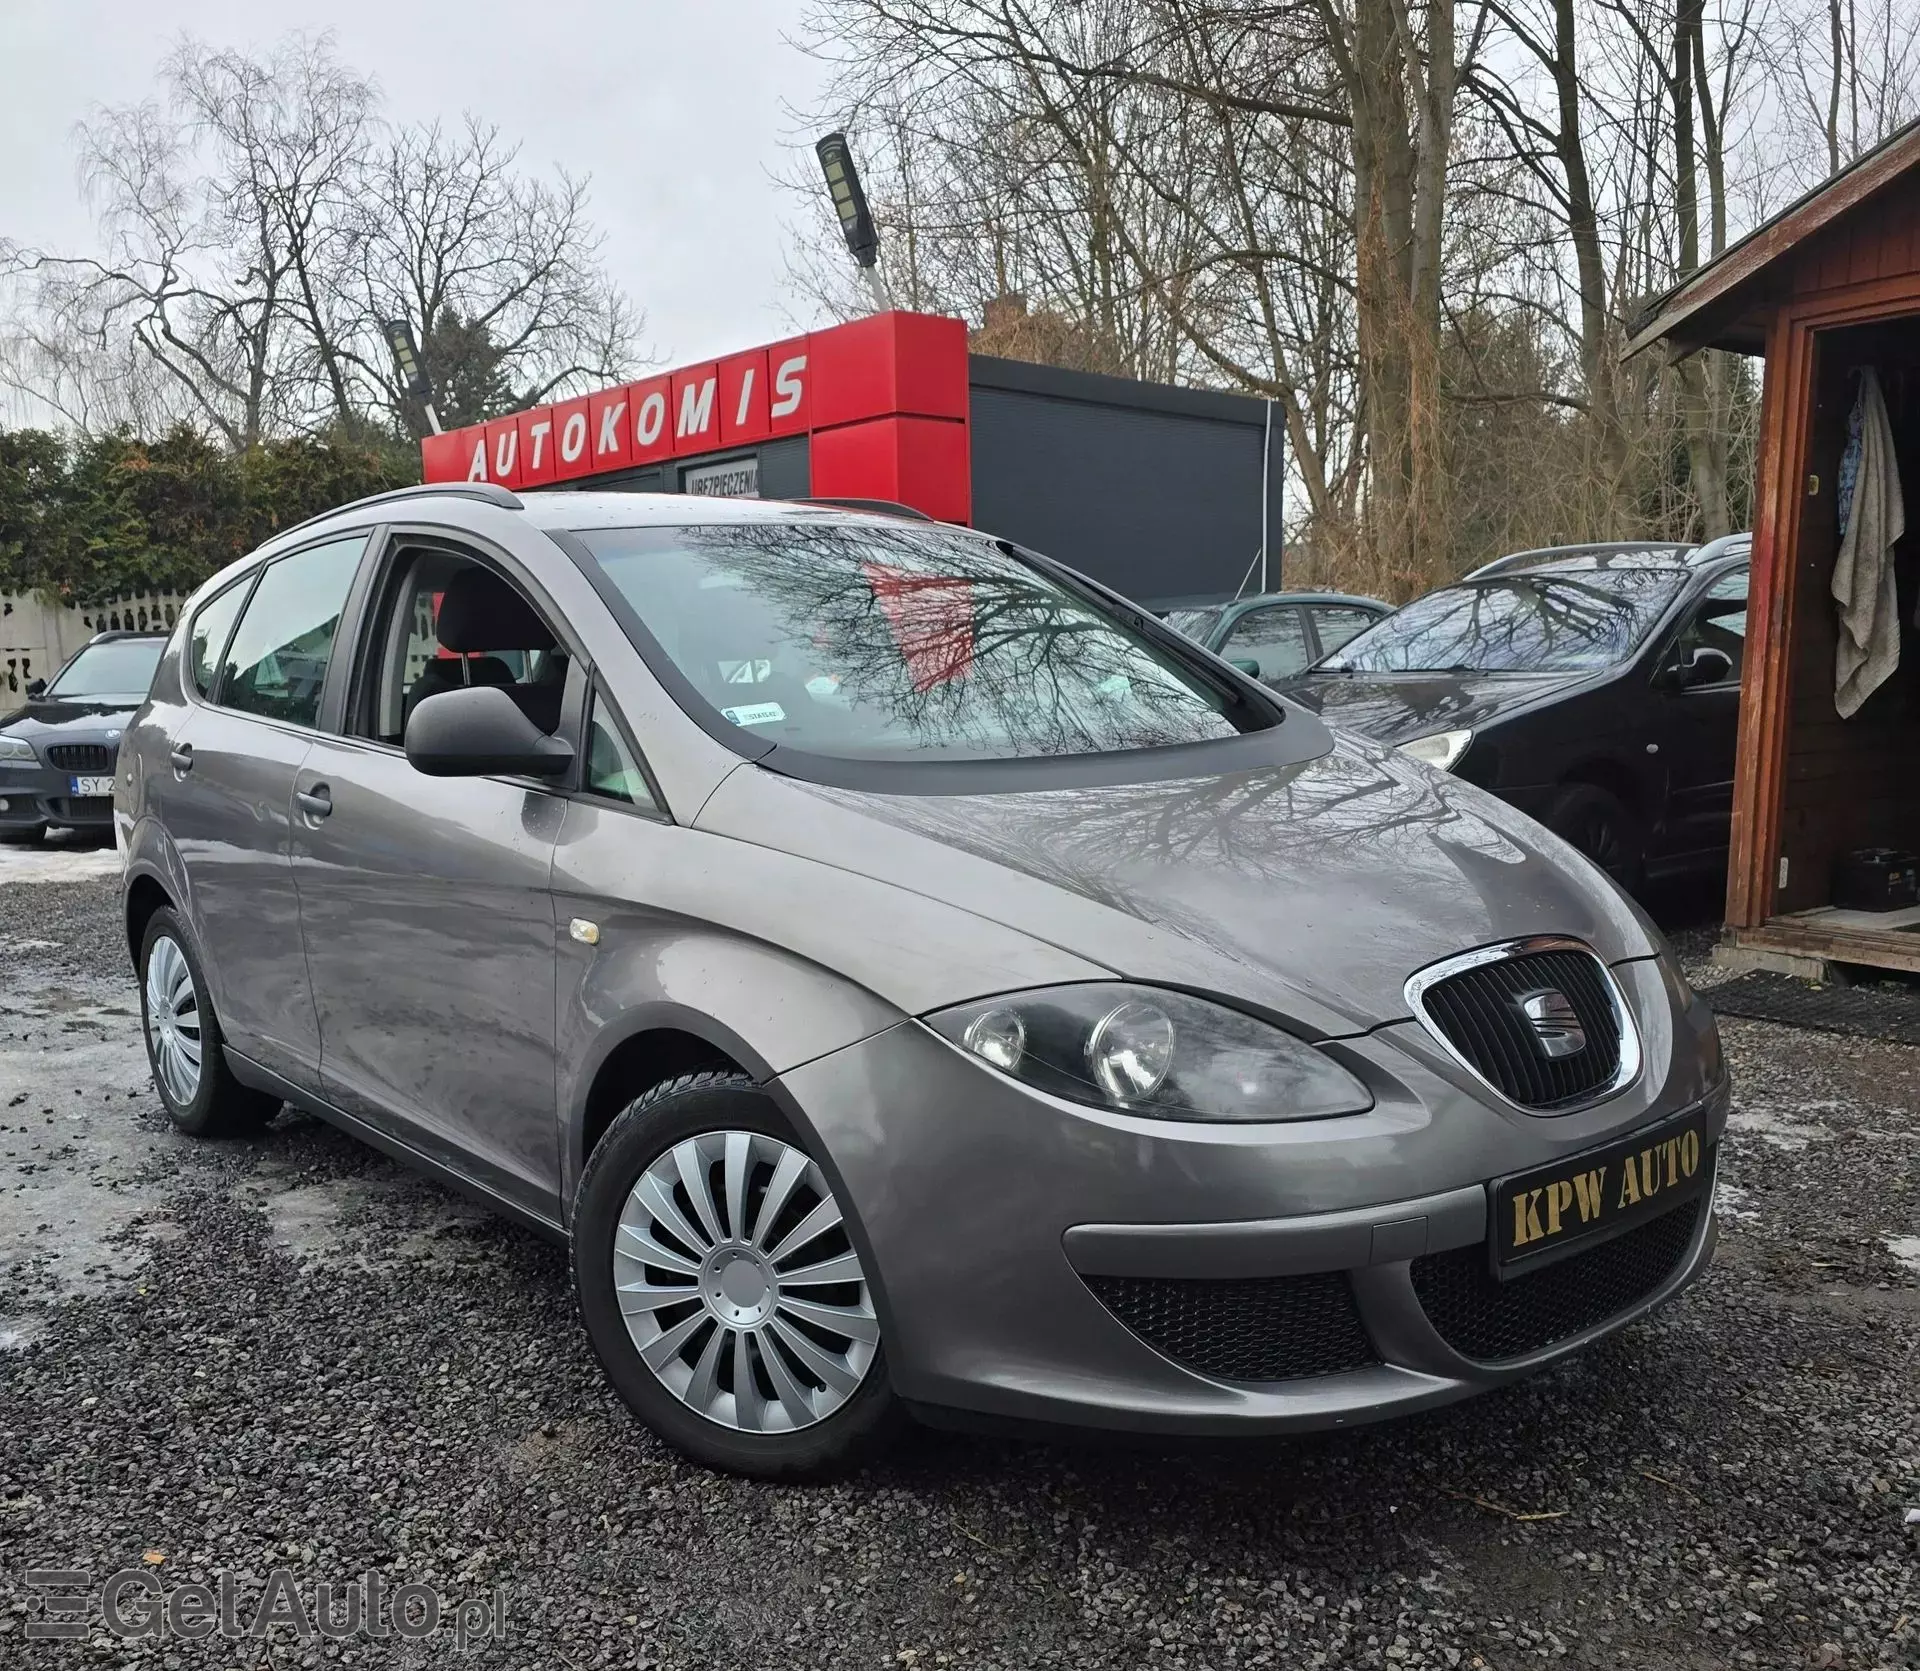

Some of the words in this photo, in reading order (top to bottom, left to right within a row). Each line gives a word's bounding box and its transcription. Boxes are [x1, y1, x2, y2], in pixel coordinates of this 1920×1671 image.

[468, 355, 807, 483] AUTOKOMIS
[81, 777, 100, 792] SY
[1512, 1166, 1607, 1248] KPW
[1617, 1128, 1700, 1210] AUTO
